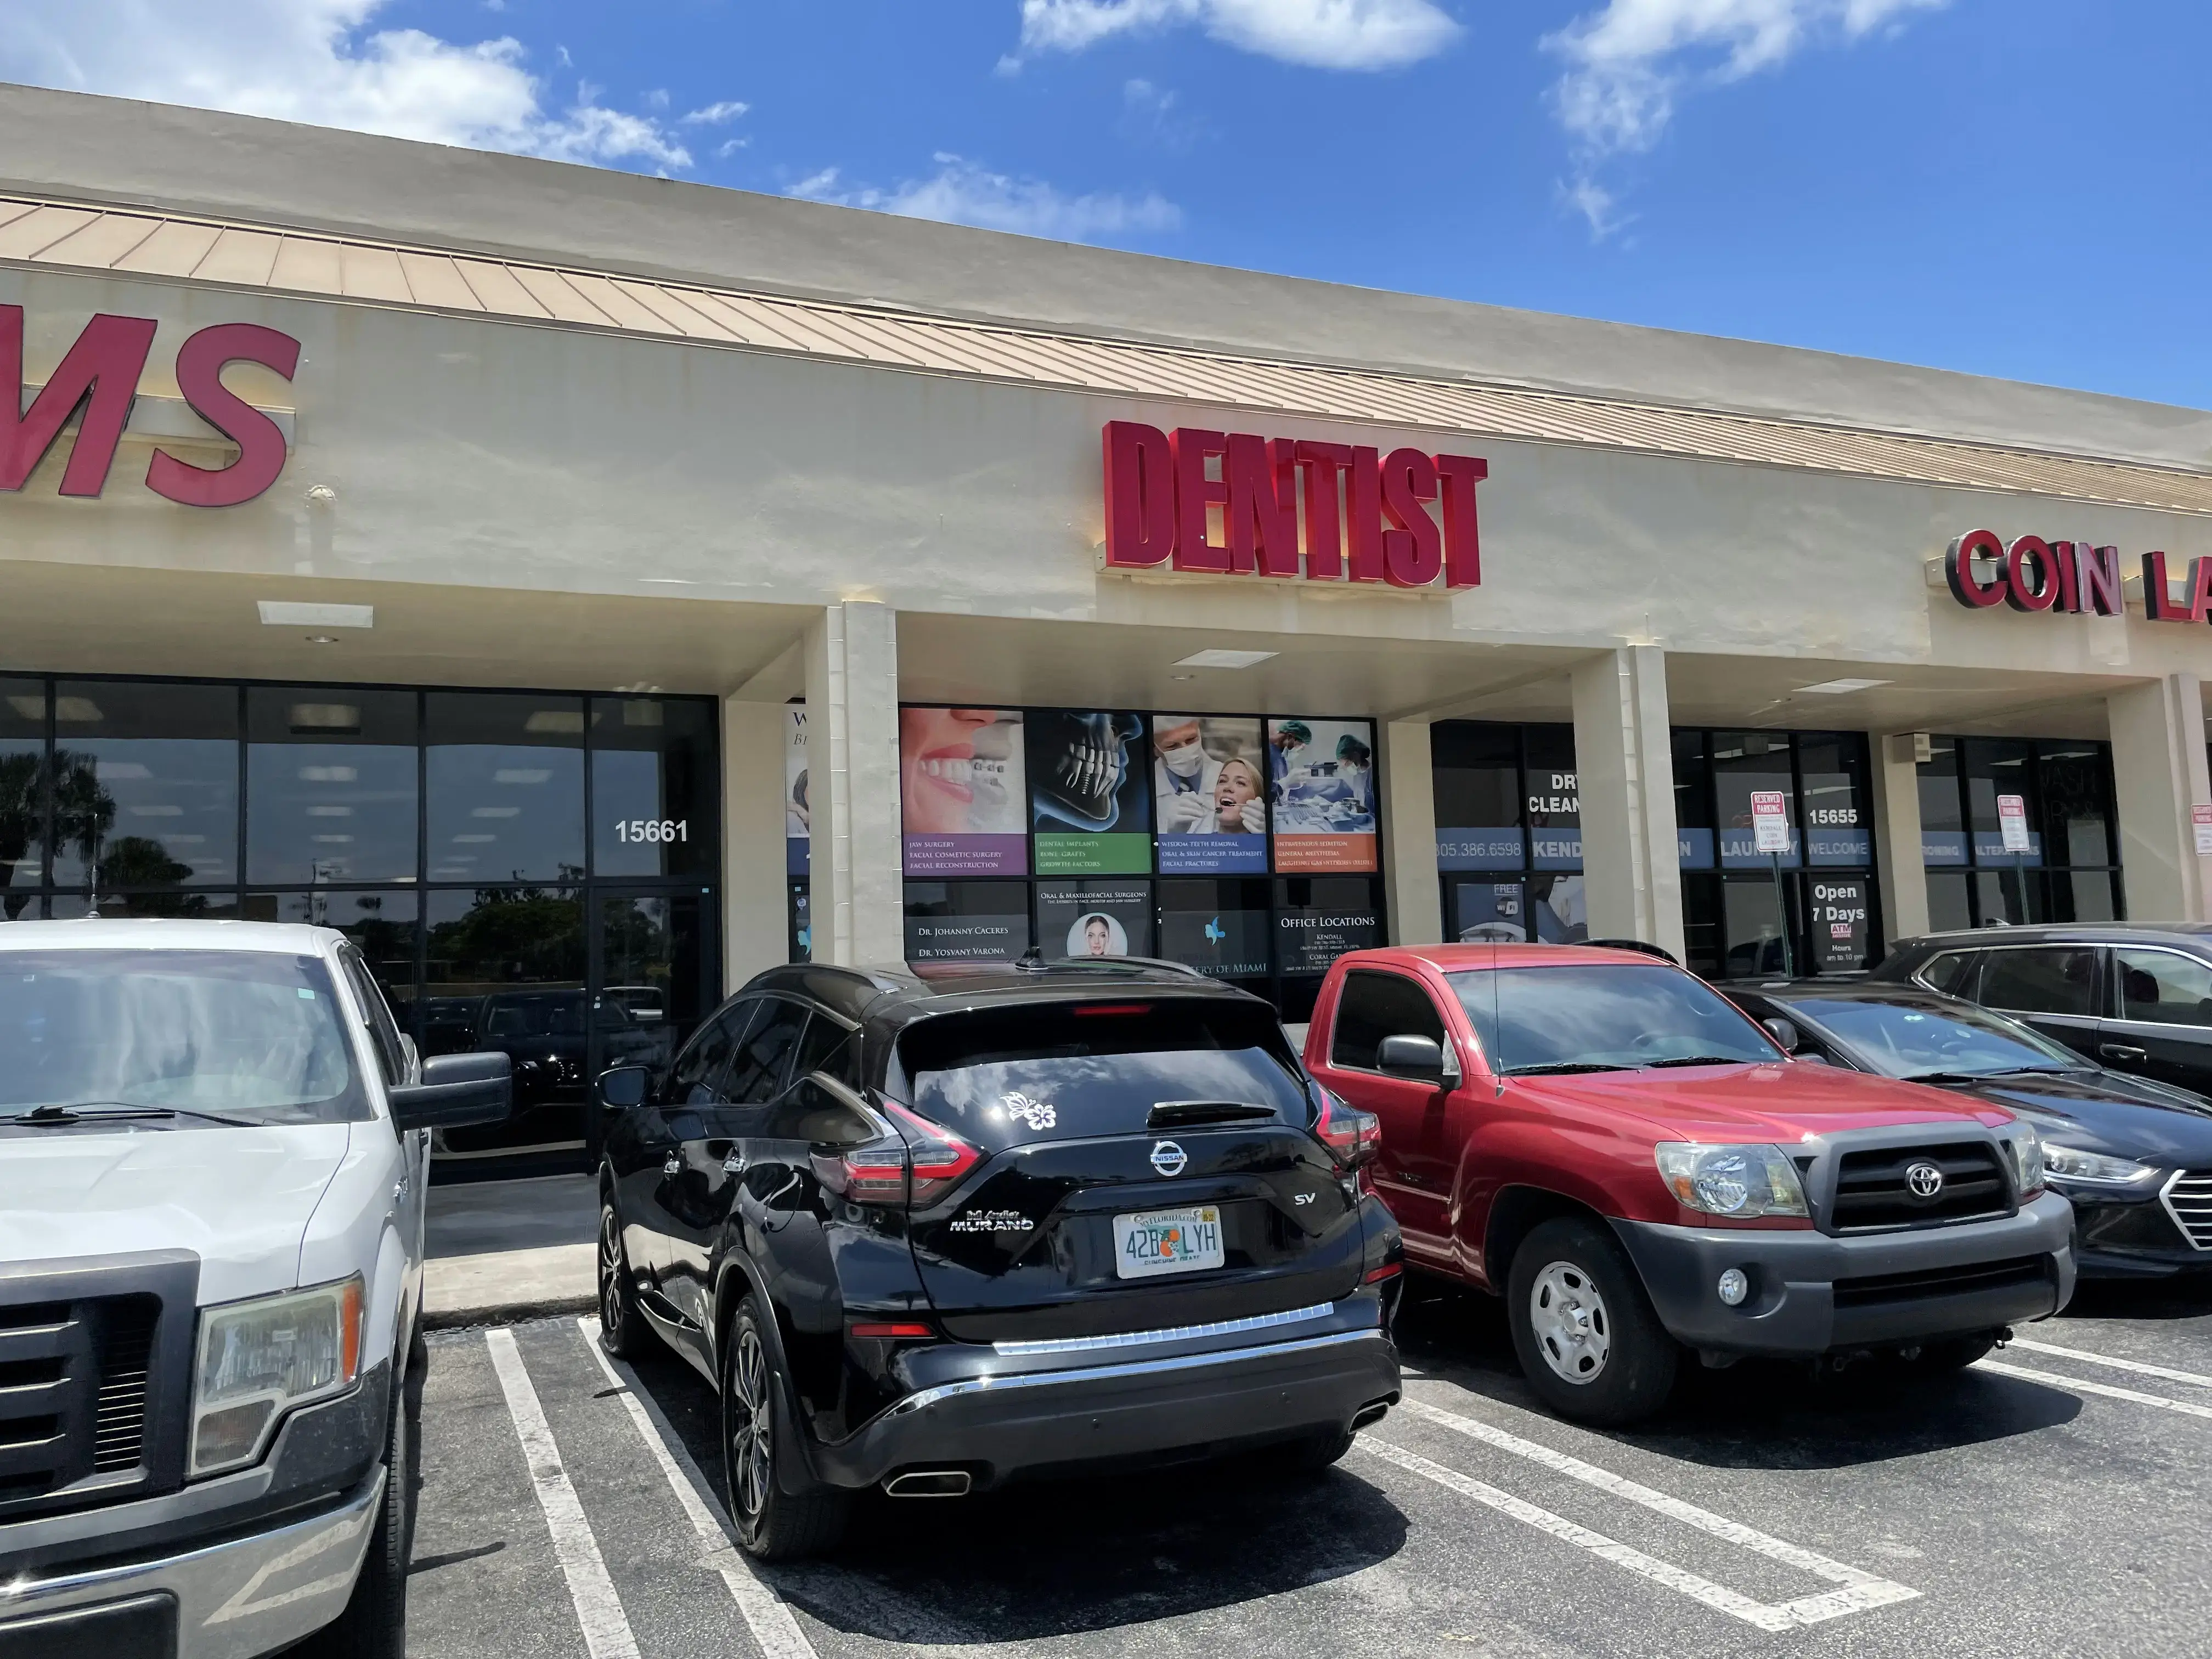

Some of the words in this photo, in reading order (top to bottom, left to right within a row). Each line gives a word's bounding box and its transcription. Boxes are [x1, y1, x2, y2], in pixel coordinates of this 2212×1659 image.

[1103, 420, 1488, 589] DENTIST
[1945, 529, 2123, 616] COIN
[1551, 774, 1578, 789] DR
[1754, 794, 1780, 803] RESERVED
[1757, 804, 1780, 813] PARKING
[1810, 809, 1858, 824] 15655
[615, 820, 687, 842] 15661
[1808, 842, 1867, 854] WELCOME
[1494, 884, 1519, 894] FREE
[1814, 884, 1857, 902] Open
[1813, 907, 1820, 922] 7
[1826, 906, 1865, 923] Days
[1281, 917, 1317, 928] OFFICE
[1319, 917, 1375, 927] LOCATIONS
[935, 928, 973, 936] JOHANNY
[1234, 963, 1266, 973] MIAMI
[1295, 1193, 1316, 1206] SV
[950, 1220, 1034, 1232] MURANO
[1182, 1223, 1216, 1254] LYH
